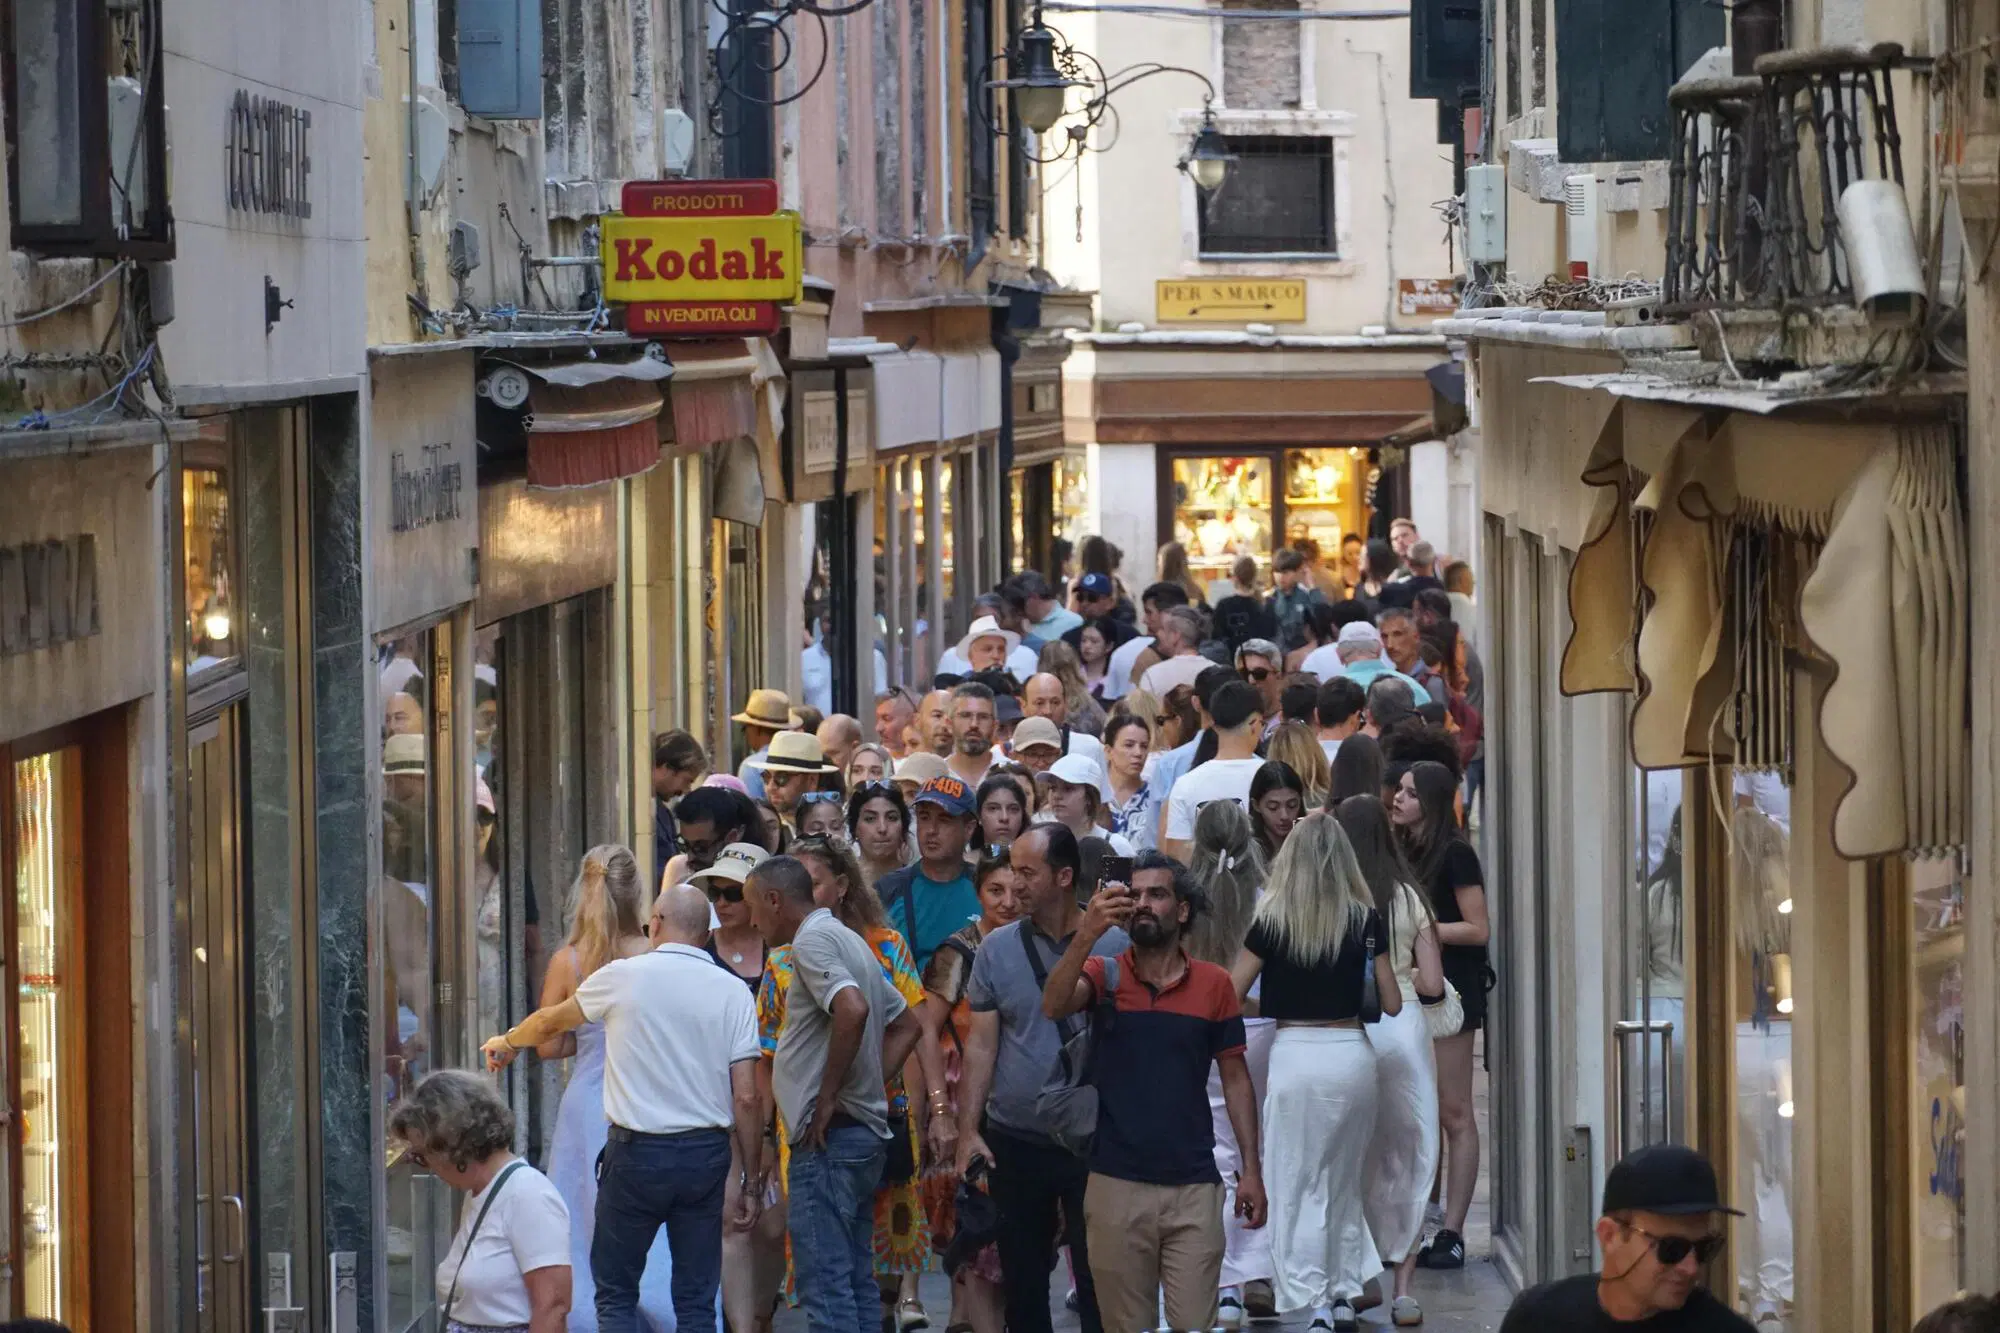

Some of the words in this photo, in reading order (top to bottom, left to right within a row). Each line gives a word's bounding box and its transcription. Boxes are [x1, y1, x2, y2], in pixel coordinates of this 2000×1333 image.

[652, 194, 744, 210] PRODOTTI
[613, 237, 786, 281] Kodak
[1163, 285, 1201, 300] PER
[1227, 285, 1300, 300] MARCO
[644, 308, 660, 323] IN
[663, 307, 727, 323] VENDITA
[729, 307, 757, 322] QUI
